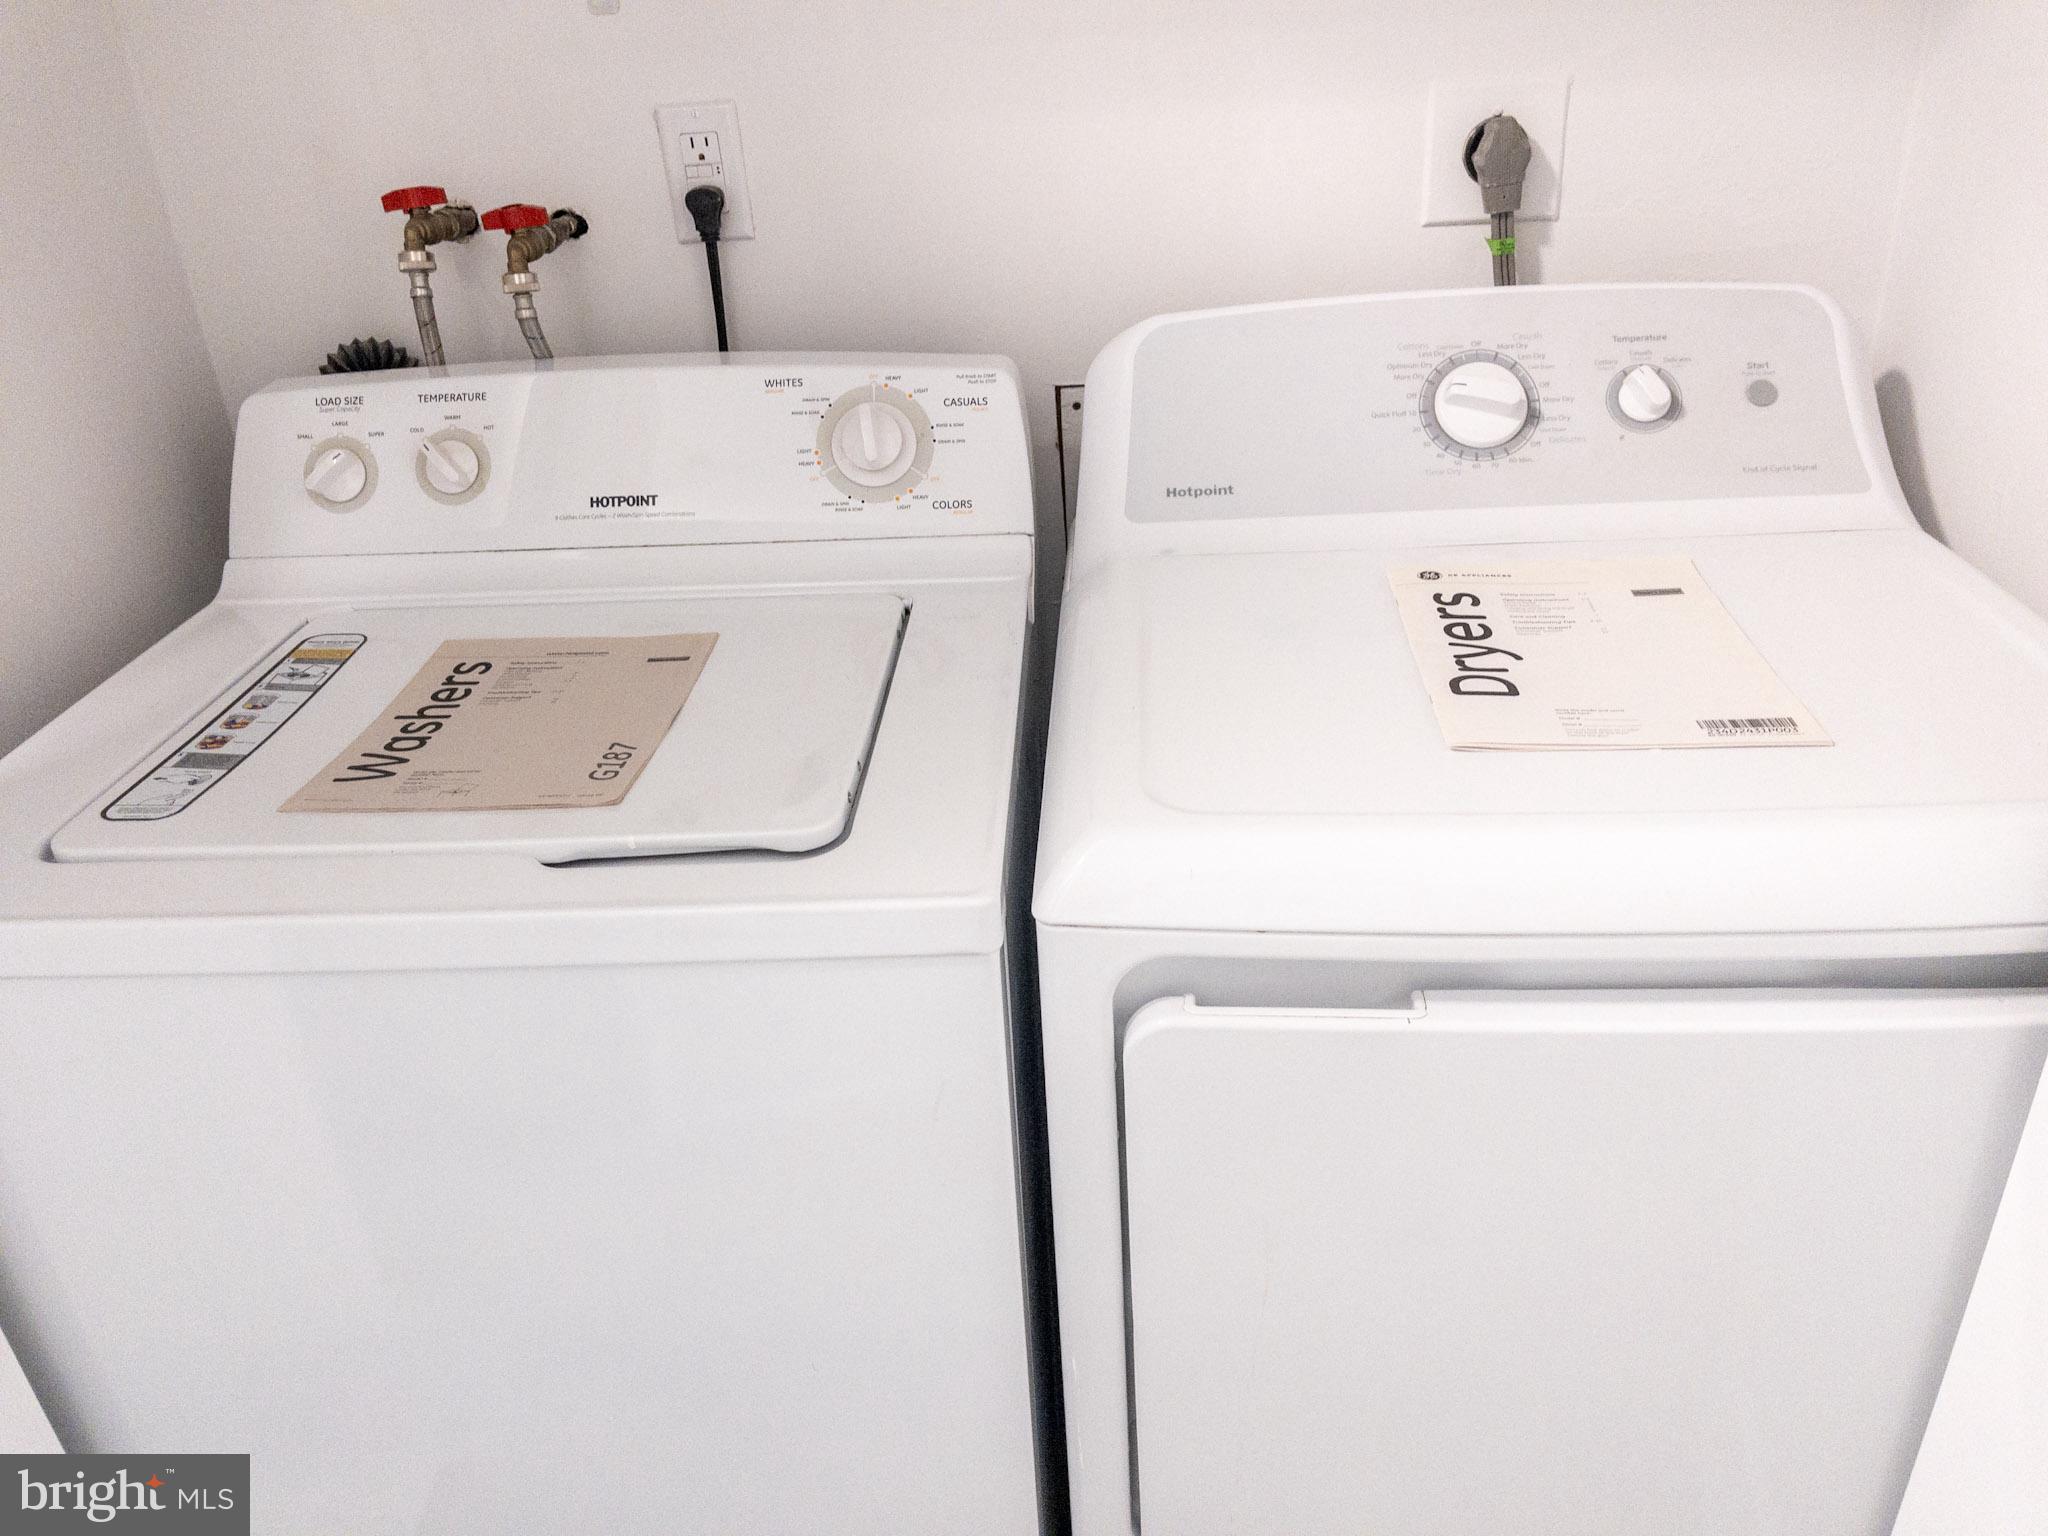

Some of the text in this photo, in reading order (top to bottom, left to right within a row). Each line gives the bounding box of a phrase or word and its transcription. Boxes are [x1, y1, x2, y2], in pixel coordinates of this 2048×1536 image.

[1612, 333, 1667, 343] Temperature
[1434, 350, 1446, 358] Dry
[1747, 361, 1769, 369] Start
[1412, 372, 1425, 380] Dry
[764, 378, 804, 388] WHITES
[315, 395, 364, 407] LOAD SIZE
[418, 392, 487, 403] TEMPERATURE
[943, 397, 988, 407] CASUALS
[1166, 484, 1234, 498] Hotpoint
[590, 494, 658, 508] HOTPOINT
[932, 499, 973, 510] COLORS
[1433, 592, 1524, 696] Dryers
[333, 661, 493, 782] Washers
[588, 742, 638, 781] G187
